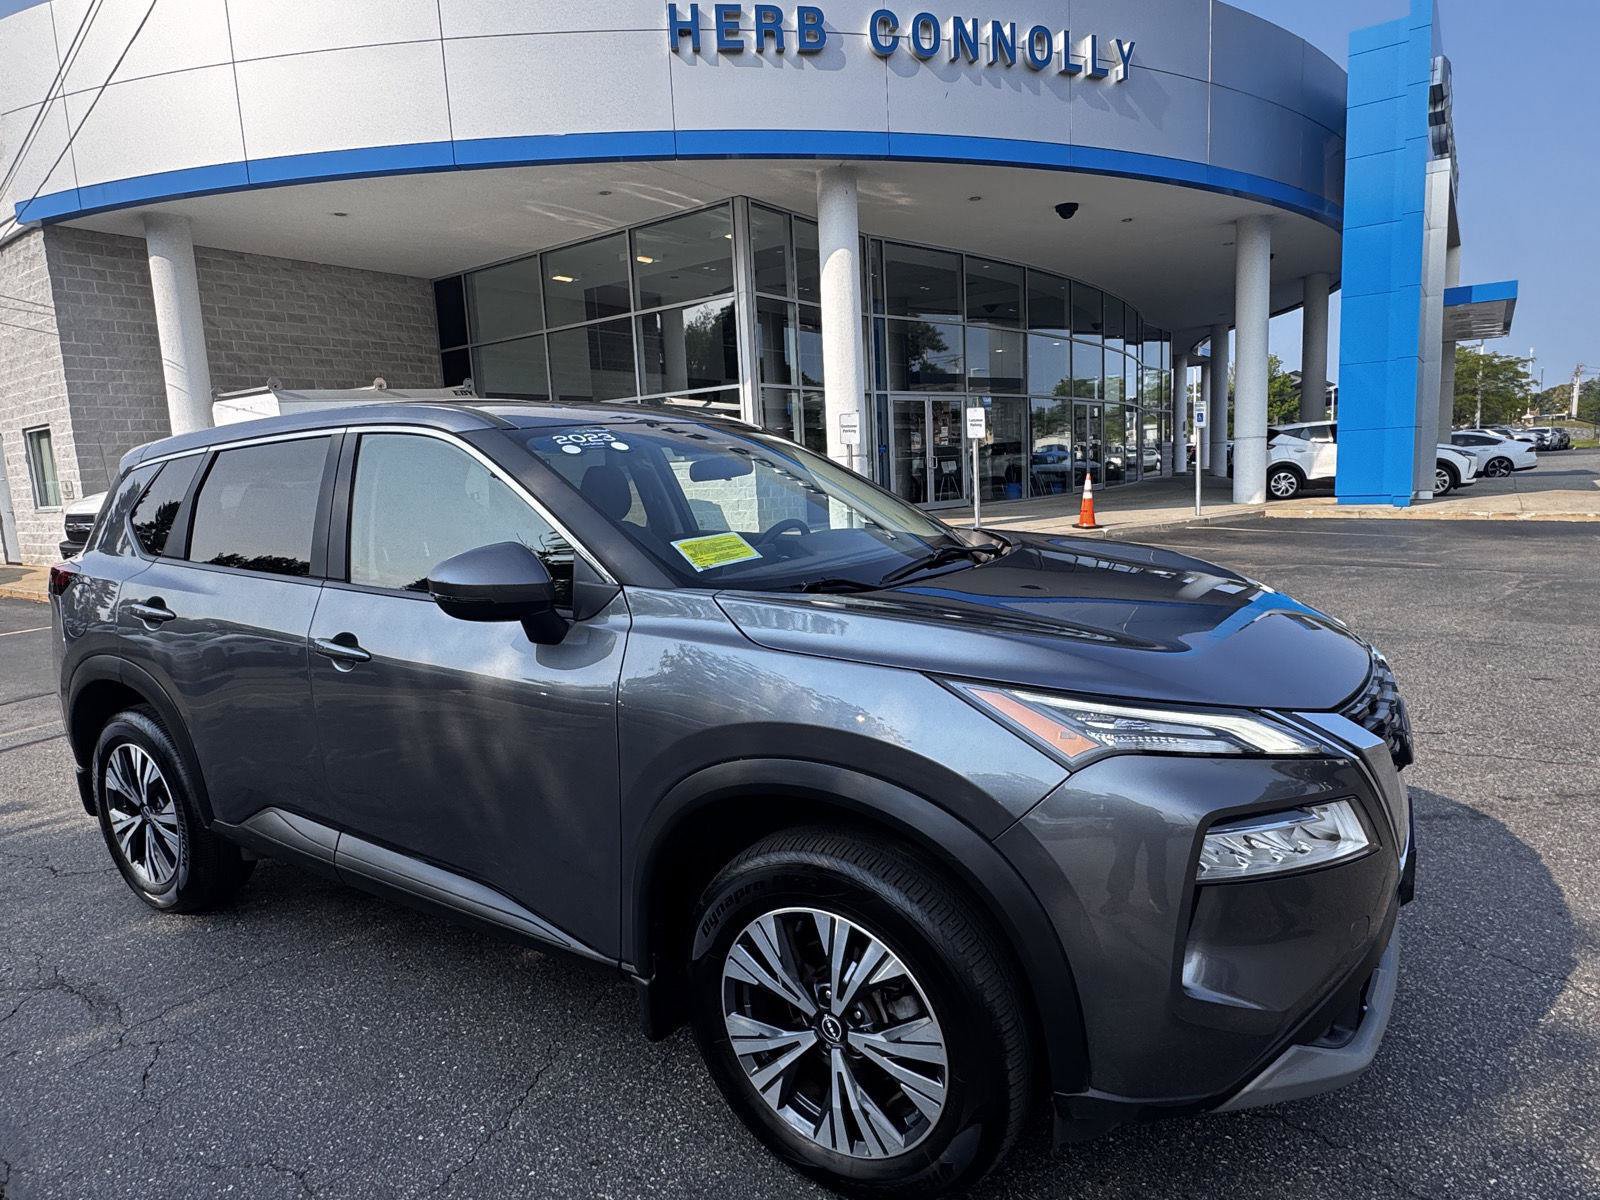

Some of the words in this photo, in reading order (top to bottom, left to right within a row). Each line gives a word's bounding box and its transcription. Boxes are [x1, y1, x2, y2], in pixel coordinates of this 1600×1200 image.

[667, 3, 828, 53] HERB
[867, 9, 1136, 82] CONNOLLY
[552, 433, 616, 445] 2023
